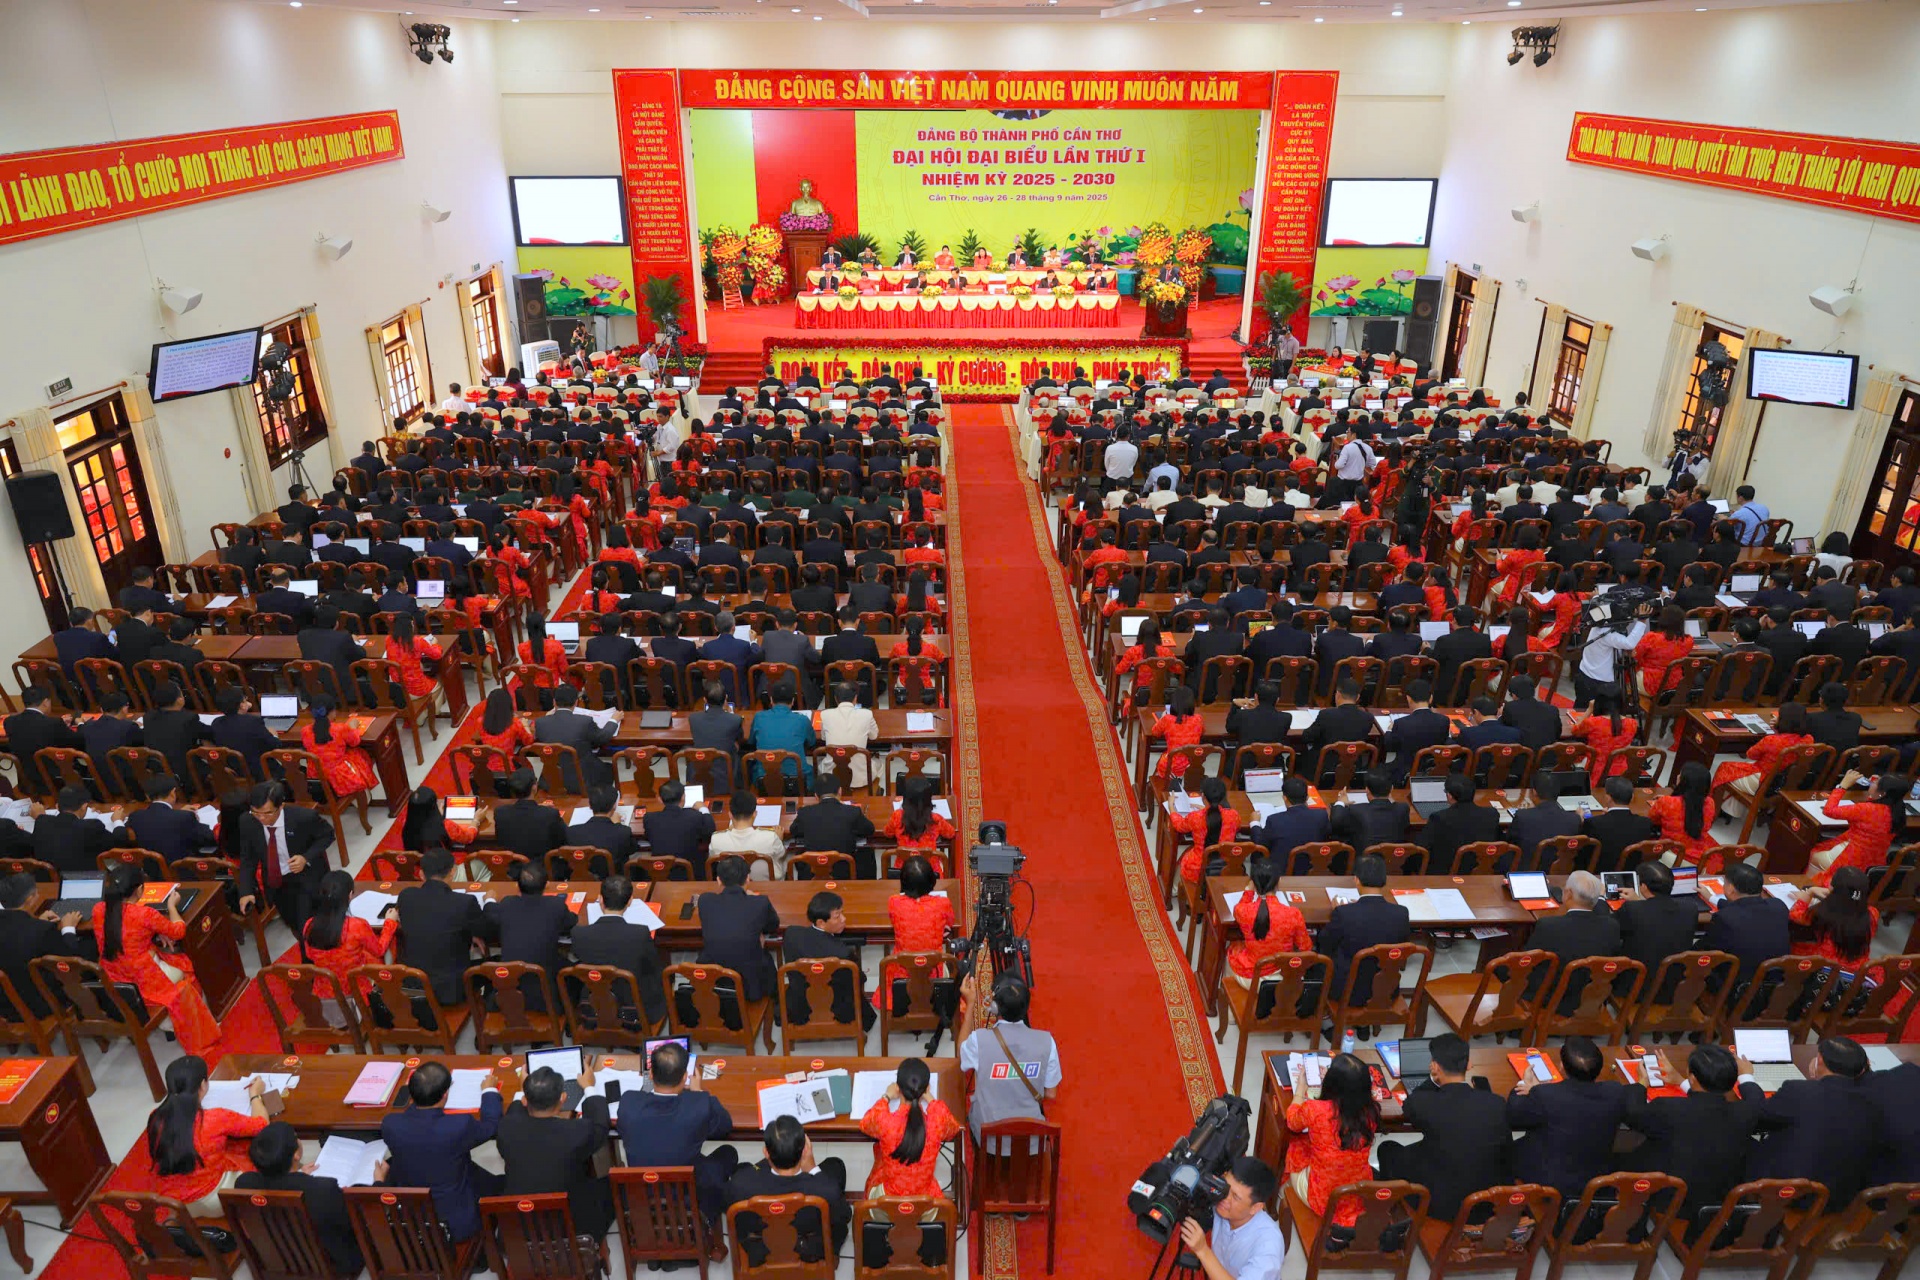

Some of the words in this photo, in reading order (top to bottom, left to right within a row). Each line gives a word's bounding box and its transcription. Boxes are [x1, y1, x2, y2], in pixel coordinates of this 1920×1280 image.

[715, 72, 772, 99] ĐẢNG
[779, 75, 835, 104] CỘNG
[891, 76, 935, 104] VIỆT
[942, 80, 988, 101] NAM
[996, 80, 1065, 103] QUANG
[1071, 80, 1117, 101] VINH
[1123, 76, 1184, 101] MUÔN
[1190, 76, 1239, 101] NĂM
[918, 128, 956, 142] ĐẢNG
[960, 128, 978, 143] BỘ
[983, 128, 1027, 141] THÀNH
[1031, 127, 1060, 141] PHỐ
[1063, 127, 1092, 141] CẦN
[1096, 128, 1122, 141] THƠ
[893, 150, 924, 167] ĐẠI
[931, 147, 962, 167] HỘI
[967, 150, 999, 167] ĐẠI
[1005, 145, 1047, 164] BIỂU
[1054, 145, 1090, 164] LẦN
[1096, 147, 1133, 164] THỨ
[1136, 150, 1146, 163] I
[1577, 124, 1597, 154] TOÀN
[1615, 128, 1637, 160] TOÀN
[1652, 133, 1676, 166] TOÀN
[1673, 135, 1699, 171] QUÂN
[1696, 134, 1728, 174] QUYẾT
[1724, 140, 1749, 177] TÂM
[1746, 145, 1776, 186] THỰC
[1773, 147, 1803, 191] HIỆN
[1799, 146, 1841, 192] THẮNG
[1836, 155, 1862, 201] LỢI
[1857, 162, 1896, 208] NGHỊ
[1892, 166, 1920, 207] QUY
[10, 172, 68, 222] LÃNH
[65, 169, 112, 216] ĐẠO,
[108, 151, 135, 203] TỔ
[135, 153, 180, 199] CHỨC
[179, 153, 211, 194] MỌI
[208, 140, 254, 184] THẮNG
[252, 140, 274, 181] LỢI
[273, 134, 299, 173] CỦA
[297, 134, 327, 168] CÁCH
[325, 132, 354, 166] MẠNG
[352, 125, 373, 161] VIỆT
[372, 126, 395, 153] NAM!
[922, 171, 979, 188] NHIỆM
[985, 171, 1008, 186] KỲ
[1013, 174, 1055, 186] 2025
[1073, 174, 1115, 186] 2030
[949, 195, 970, 203] Thơ,
[973, 195, 995, 203] ngày
[1029, 194, 1055, 203] tháng
[862, 357, 889, 380] DÂ
[937, 355, 954, 386] KỶ
[959, 358, 1007, 386] CƯƠNG
[996, 1066, 1006, 1077] TH
[1027, 1065, 1037, 1076] CT
